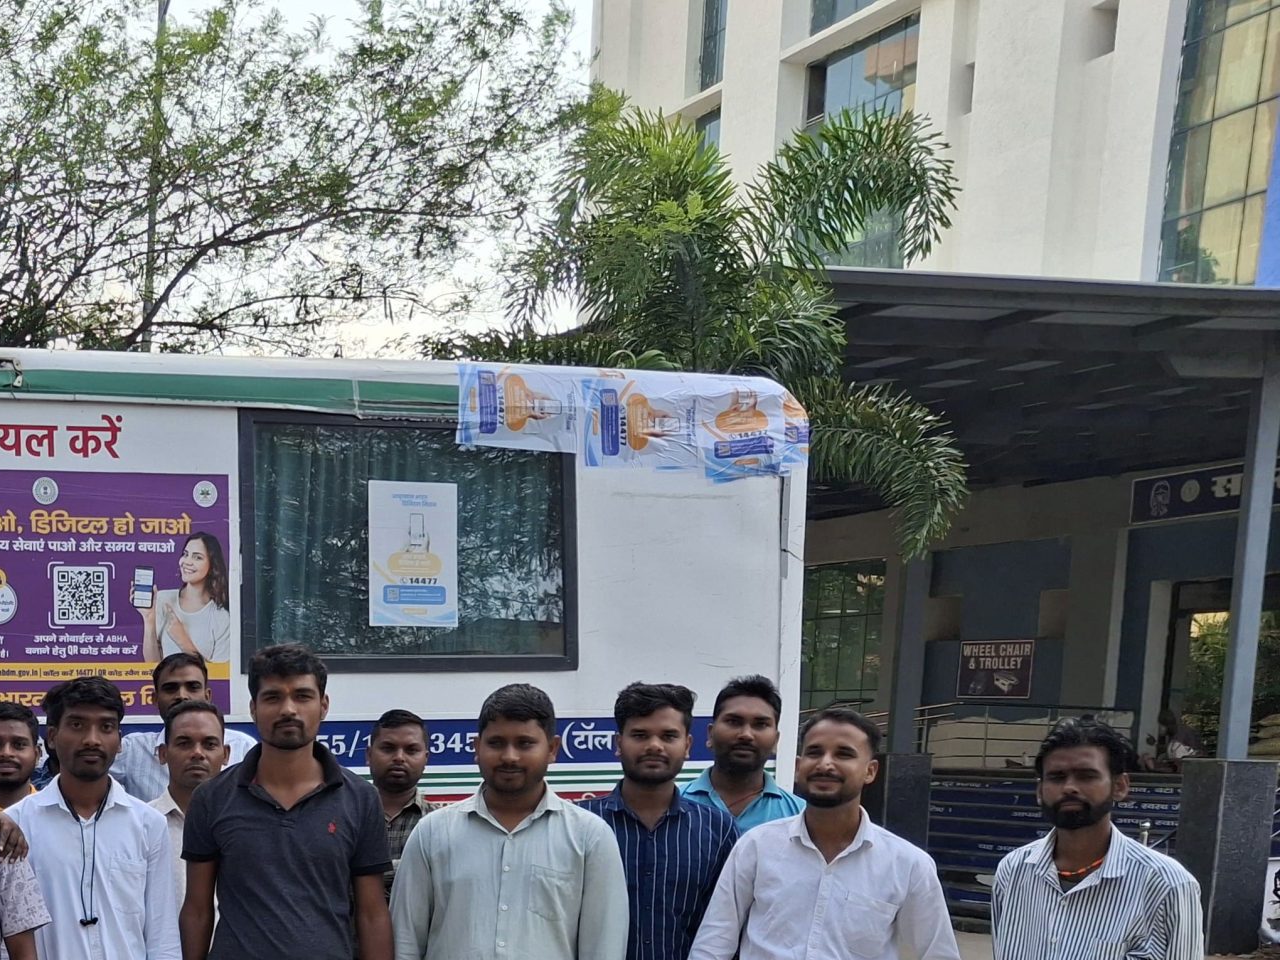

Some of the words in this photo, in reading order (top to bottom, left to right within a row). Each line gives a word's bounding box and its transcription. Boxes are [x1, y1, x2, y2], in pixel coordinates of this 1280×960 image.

[67, 415, 123, 459] करें
[29, 510, 108, 534] डिजिटल
[113, 511, 136, 536] हो
[139, 513, 192, 535] जाओ
[48, 537, 75, 552] पाओ
[79, 538, 103, 553] और
[105, 542, 135, 553] समय
[138, 538, 175, 553] बचाओ
[409, 577, 438, 585] 14477
[34, 633, 57, 643] अपने
[95, 633, 104, 643] से
[25, 645, 50, 655] बनाने
[52, 645, 67, 659] हेतु
[67, 645, 78, 655] QR
[80, 645, 99, 655] कोड
[122, 645, 138, 655] करें
[963, 644, 996, 657] WHEEL
[1000, 643, 1031, 656] CHAIR
[980, 657, 1023, 669] TROLLEY
